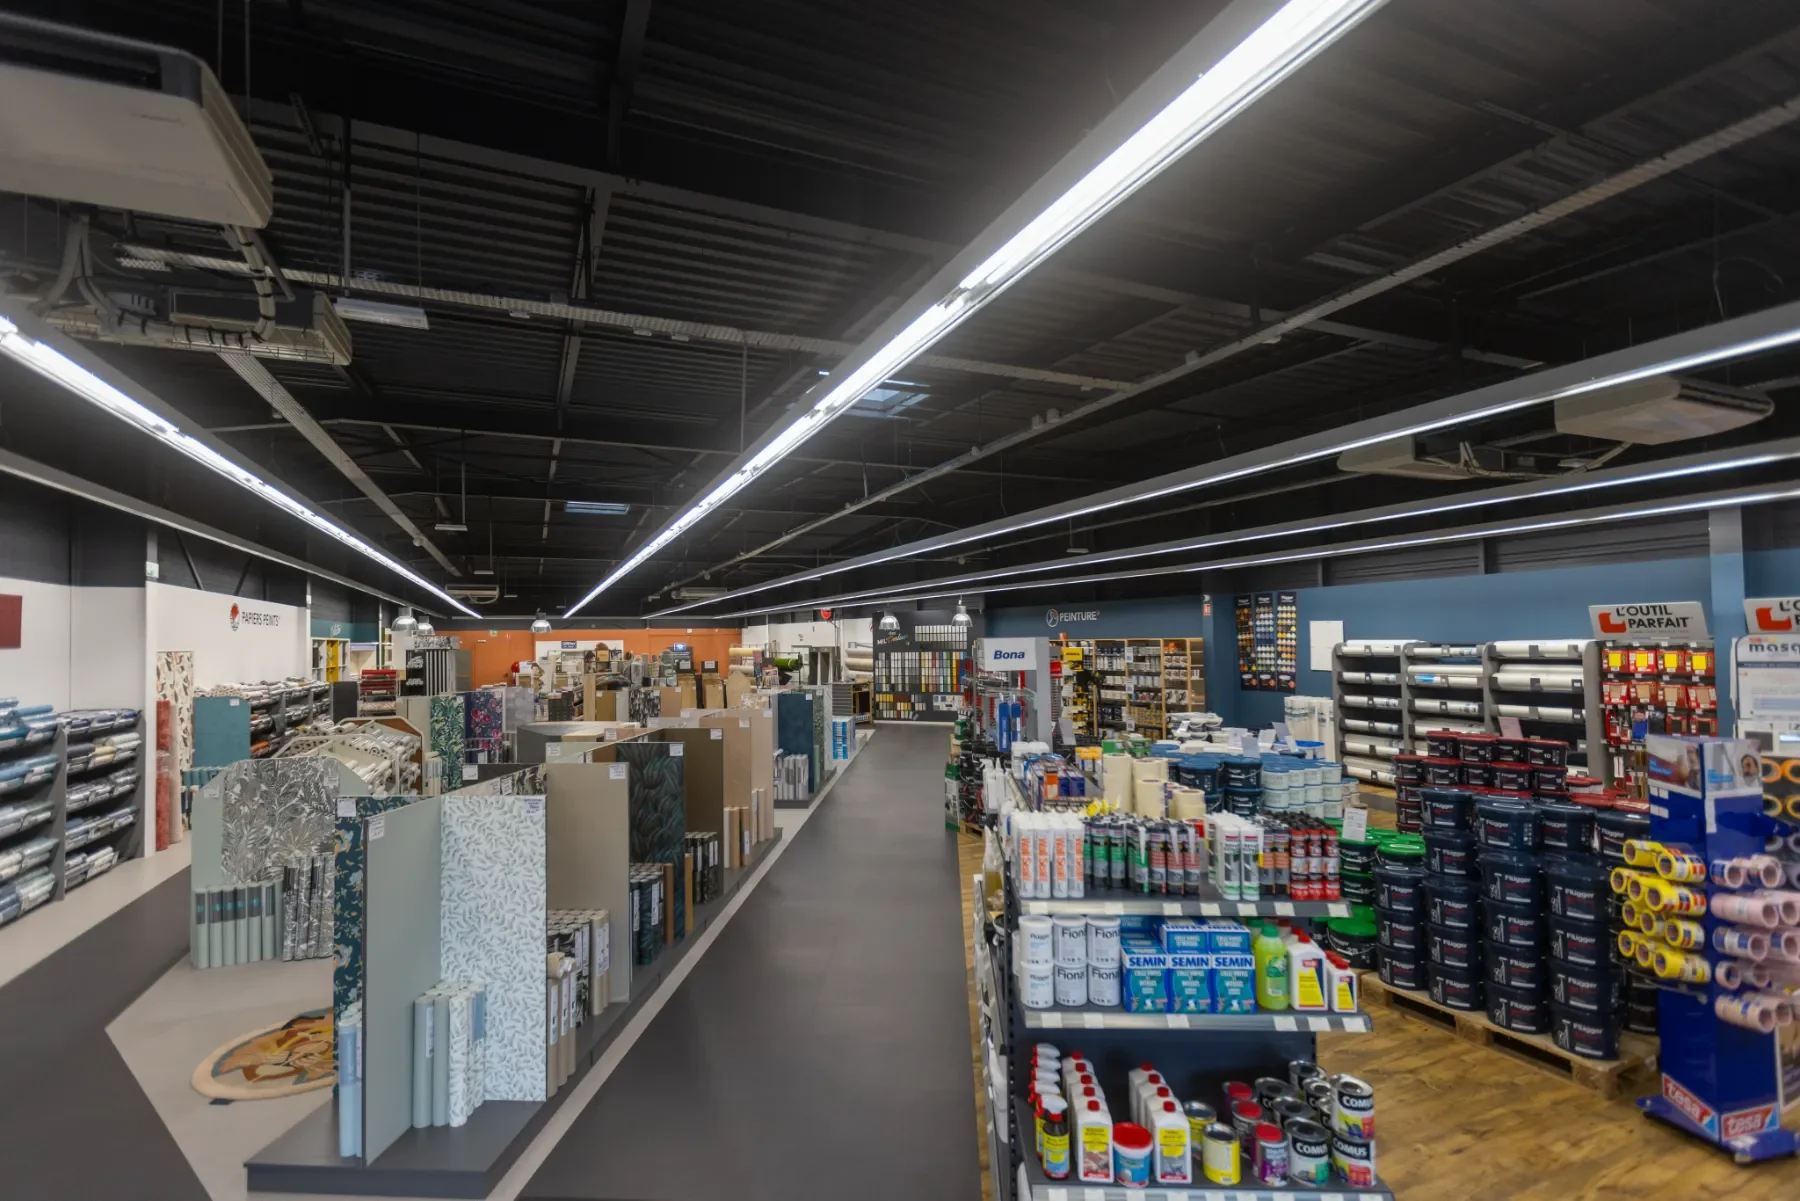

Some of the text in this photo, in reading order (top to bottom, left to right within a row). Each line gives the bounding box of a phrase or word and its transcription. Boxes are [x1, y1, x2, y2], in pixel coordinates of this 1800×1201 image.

[1060, 611, 1097, 621] PEINTURE
[1616, 604, 1673, 617] L'OUTIL
[242, 611, 279, 626] PAPIERS PEINTS
[1628, 617, 1690, 629] PARFAIT
[993, 649, 1026, 660] Bona
[1129, 956, 1166, 967] SEMIN
[1172, 956, 1209, 967] SEMIN
[1215, 956, 1252, 967] SEMIN
[1667, 1082, 1701, 1122] tesa
[1728, 1114, 1762, 1133] tesa
